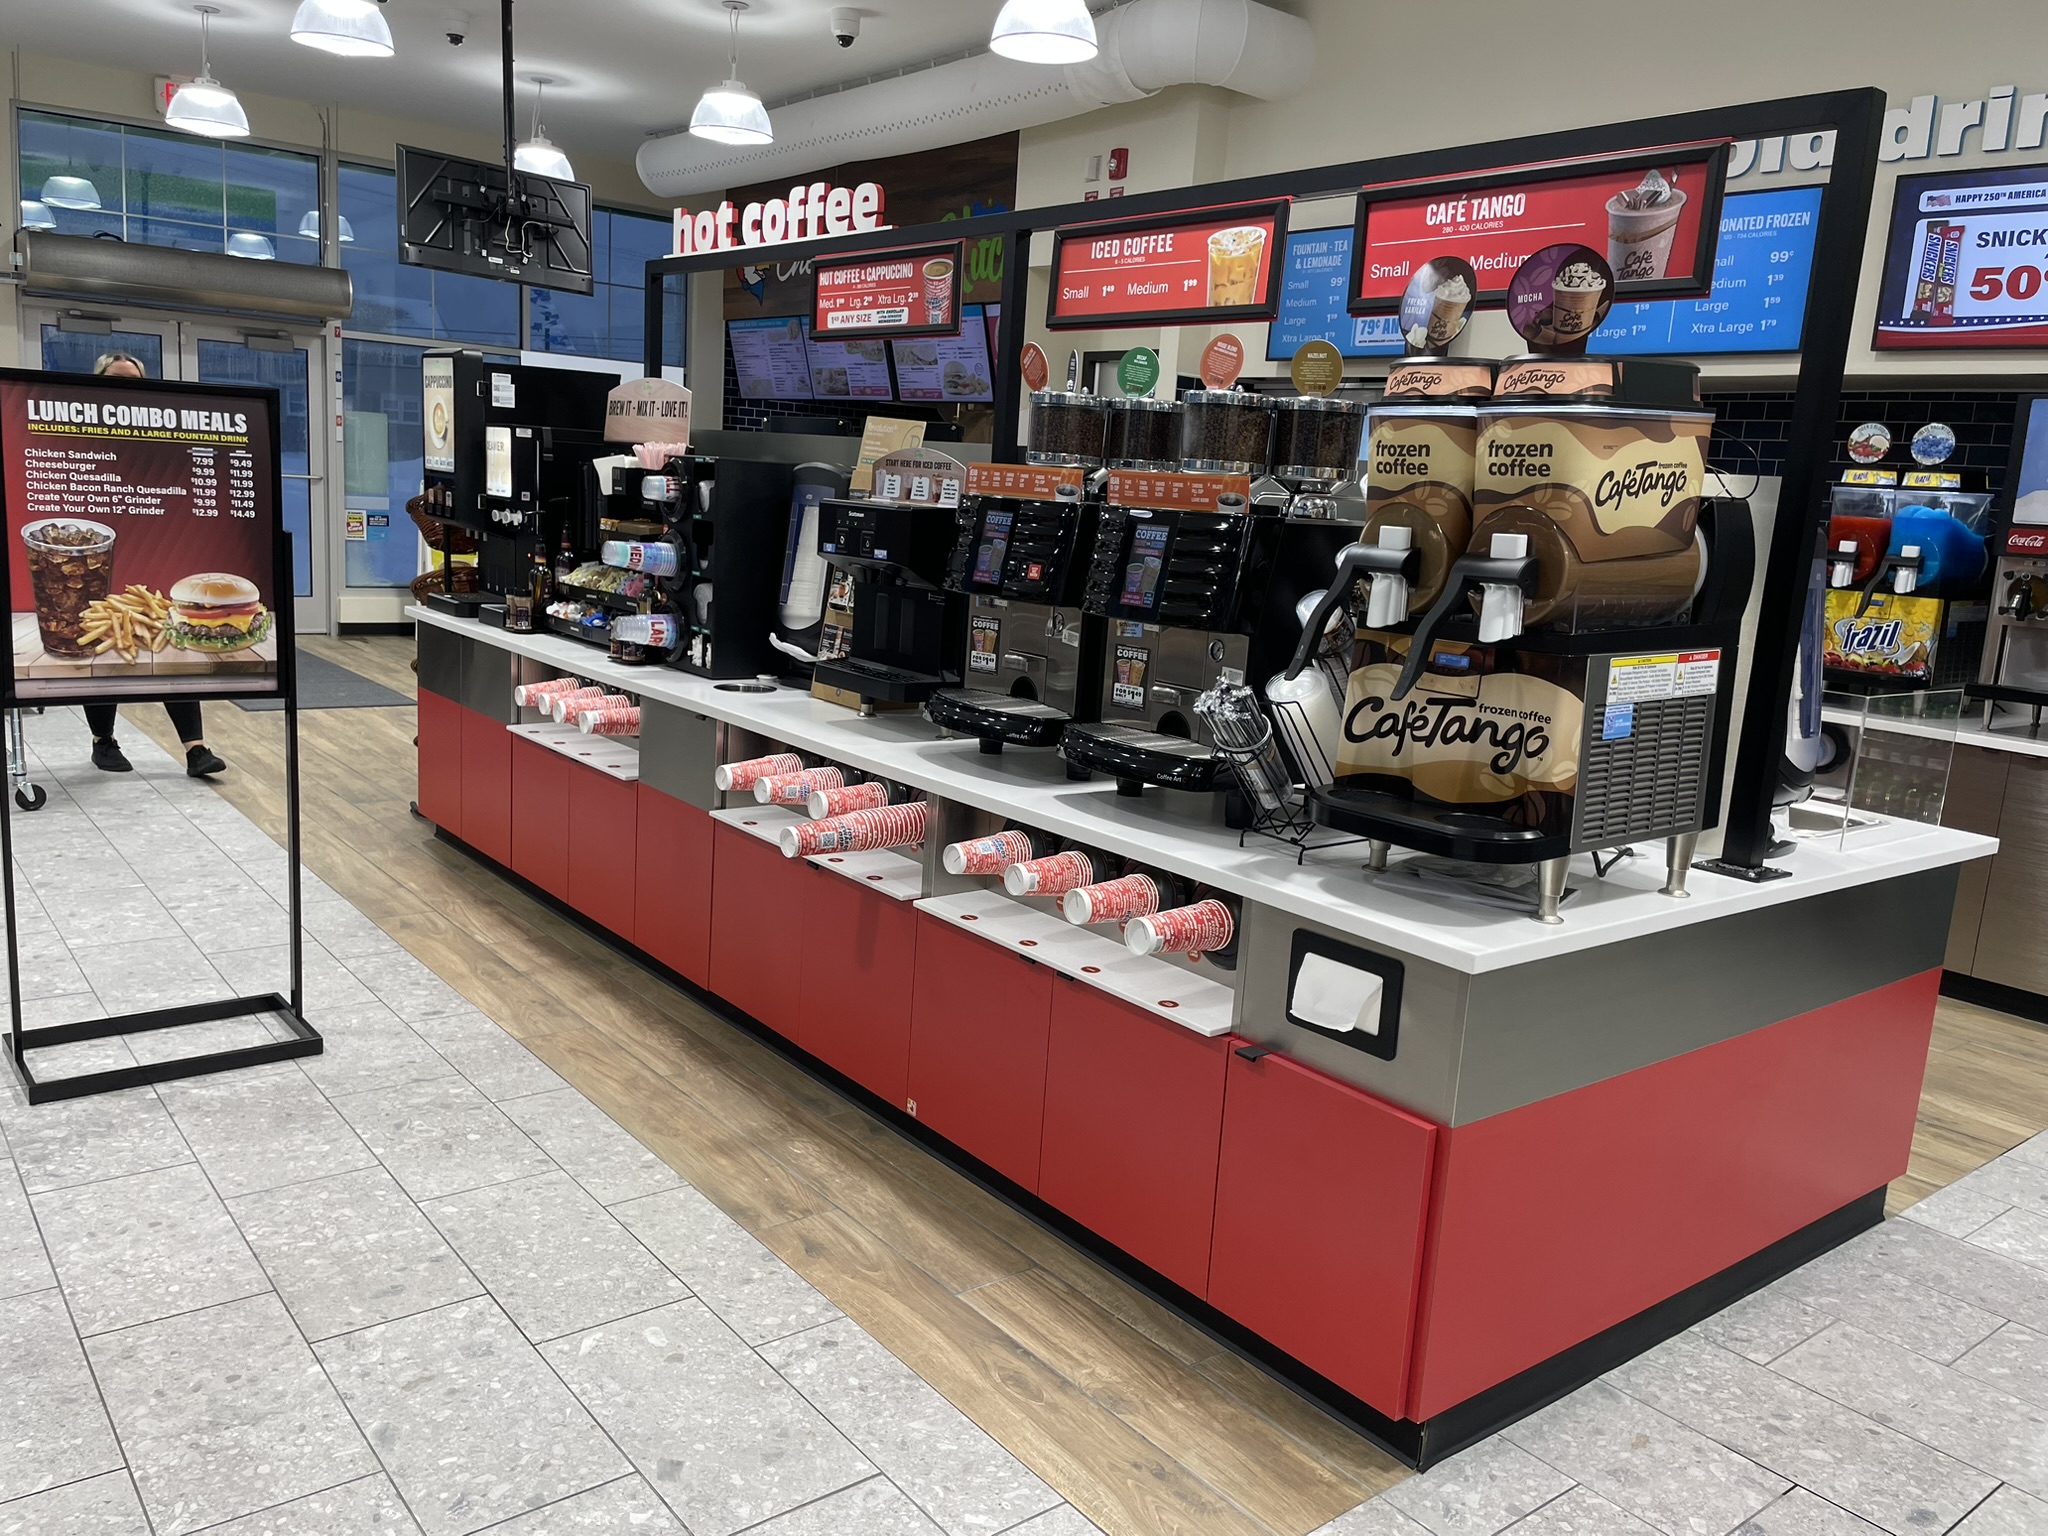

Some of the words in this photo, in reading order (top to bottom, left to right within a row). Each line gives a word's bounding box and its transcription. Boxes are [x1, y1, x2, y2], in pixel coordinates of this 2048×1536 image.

[1955, 193, 1983, 203] HAPPY
[2007, 189, 2046, 200] AMERICA
[1426, 194, 1466, 226] CAFÉ
[1471, 193, 1526, 221] TANGO
[673, 201, 738, 255] hot
[742, 182, 885, 248] coffee
[1459, 224, 1470, 232] 420
[1471, 221, 1503, 231] CALORIES
[1766, 211, 1811, 229] FROZEN
[1091, 240, 1120, 259] ICED
[1124, 234, 1174, 256] COFFEE
[1293, 243, 1327, 256] FOUNTAIN
[1334, 240, 1348, 252] TEA
[1296, 259, 1302, 269] &
[1303, 255, 1342, 269] LEMONADE
[1624, 251, 1653, 266] Café
[1922, 234, 1941, 282] SNICKERS
[1941, 241, 1958, 285] SNICKERS
[820, 272, 834, 286] HOT
[834, 268, 860, 285] COFFEE
[861, 270, 866, 280] &
[867, 262, 913, 281] CAPPUCCINO
[1370, 261, 1410, 279] Small
[1617, 265, 1655, 280] Tango
[1063, 286, 1089, 298] Small
[1127, 281, 1168, 295] Medium
[1288, 280, 1309, 290] Small
[1711, 277, 1746, 289] edium
[1969, 265, 2048, 301] 50
[850, 297, 862, 308] Lrg.
[878, 295, 892, 304] Xtra
[893, 294, 906, 305] Lrg.
[1286, 298, 1317, 308] Medium
[1408, 298, 1427, 306] FRENCH
[1518, 292, 1543, 304] MOCHA
[1405, 306, 1425, 314] VANILLA
[1695, 301, 1729, 314] Large
[841, 315, 855, 324] ANY
[856, 314, 872, 323] SIZE
[1284, 317, 1306, 326] Large
[1596, 327, 1627, 339] Large
[1691, 323, 1715, 334] Xtra
[1718, 322, 1754, 334] Large
[1282, 334, 1297, 343] Xtra
[28, 400, 98, 424] LUNCH
[102, 404, 177, 429] COMBO
[181, 409, 247, 434] MEALS
[609, 401, 625, 415] BREW
[625, 401, 632, 416] IT
[637, 401, 649, 416] MIX
[649, 401, 655, 416] IT
[661, 401, 677, 417] LOVE
[678, 402, 688, 418] IT!
[28, 423, 80, 434] INCLUDES:
[82, 426, 109, 435] FRIES
[111, 428, 131, 436] AND
[141, 430, 172, 439] LARGE
[173, 431, 219, 442] FOUNTAIN
[220, 434, 249, 443] DRINK
[1375, 440, 1431, 458] frozen
[1488, 440, 1553, 458] frozen
[25, 448, 66, 459] Chicken
[68, 451, 117, 461] Sandwich
[192, 457, 214, 466] $7.99
[230, 459, 252, 468] $9.49
[900, 460, 911, 468] HERE
[912, 461, 922, 469] FOR
[923, 461, 933, 469] ICED
[934, 462, 951, 471] COFFEE
[25, 460, 96, 471] Cheeseburger
[192, 467, 215, 476] $9.99
[230, 469, 253, 478] $11.99
[1376, 459, 1429, 476] coffee
[1488, 458, 1551, 478] coffee
[26, 470, 65, 480] Chicken
[69, 472, 121, 483] Quesadilla
[191, 477, 217, 486] $10.99
[230, 479, 253, 488] $11.99
[26, 481, 68, 491] Chicken
[70, 483, 101, 493] Bacon
[104, 484, 134, 494] Ranch
[136, 485, 187, 496] Quesadilla
[193, 488, 216, 497] $11.99
[230, 489, 255, 498] $12.99
[27, 492, 60, 502] Create
[62, 493, 85, 502] Your
[87, 494, 109, 503] Own
[126, 495, 161, 505] Grinder
[194, 498, 216, 507] $9.99
[231, 500, 254, 508] $11.49
[27, 503, 60, 513] Create
[63, 504, 85, 513] Your
[88, 505, 110, 514] Own
[128, 506, 165, 515] Grinder
[192, 508, 219, 517] $12.99
[230, 510, 255, 519] $14.49
[986, 515, 1012, 525] COFFEE
[1136, 530, 1168, 540] COFFEE
[973, 621, 998, 630] COFFEE
[1842, 621, 1901, 653] frazil
[1117, 649, 1148, 660] COFFEE
[1479, 704, 1518, 718] frozen
[1518, 710, 1551, 725] coffee
[1157, 773, 1173, 781] Coffee
